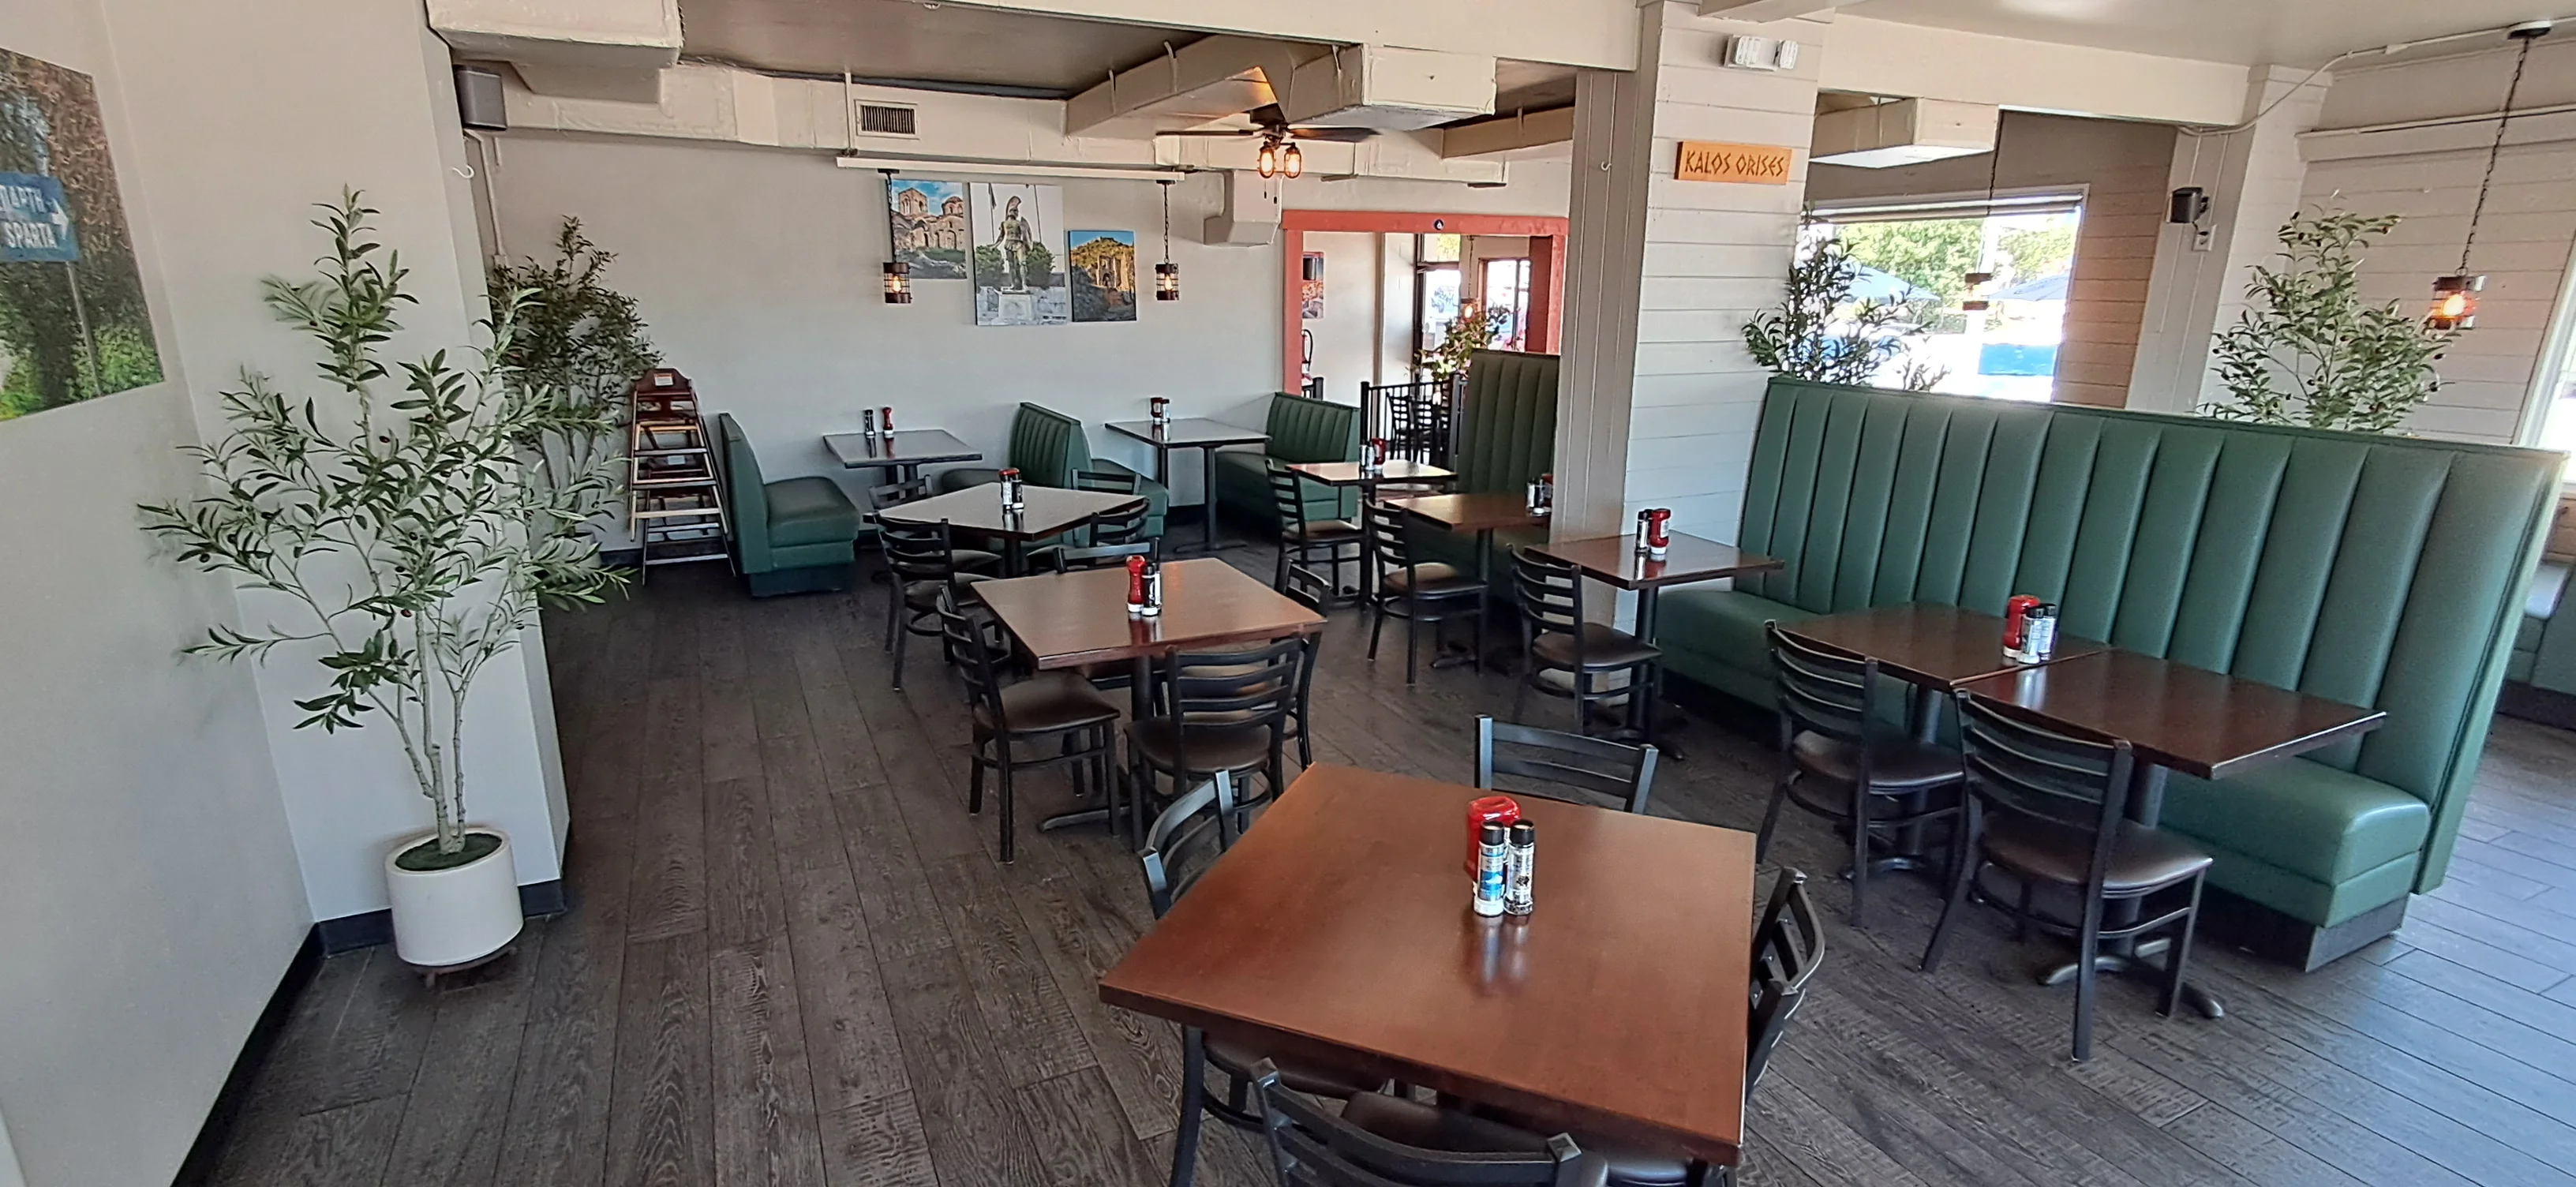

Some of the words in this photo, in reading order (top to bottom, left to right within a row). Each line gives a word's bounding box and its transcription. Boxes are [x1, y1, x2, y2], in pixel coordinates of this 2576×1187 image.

[1684, 150, 1732, 175] KALOS
[1735, 153, 1784, 178] ORISES
[3, 221, 58, 249] SPARTA
